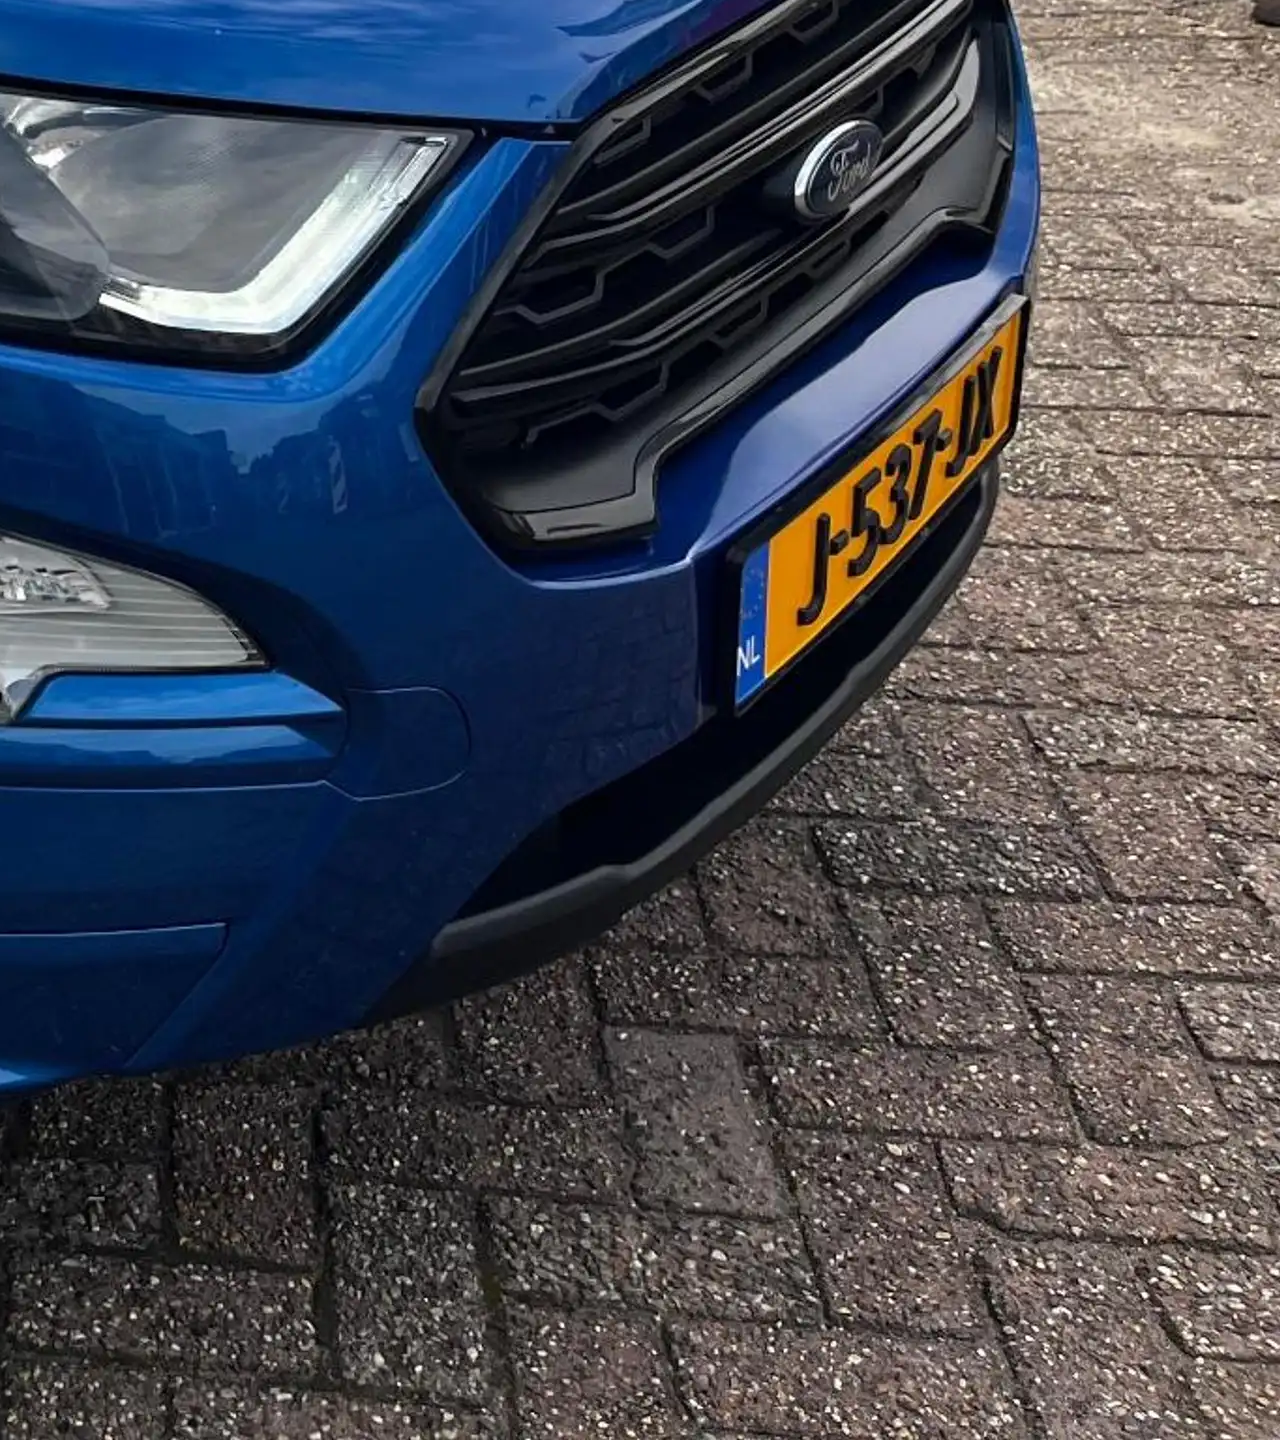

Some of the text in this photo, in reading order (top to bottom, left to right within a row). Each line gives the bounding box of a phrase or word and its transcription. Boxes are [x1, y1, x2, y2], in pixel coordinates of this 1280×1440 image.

[827, 139, 874, 202] Ford
[796, 345, 1004, 627] J-537-JX
[736, 635, 761, 677] NL
